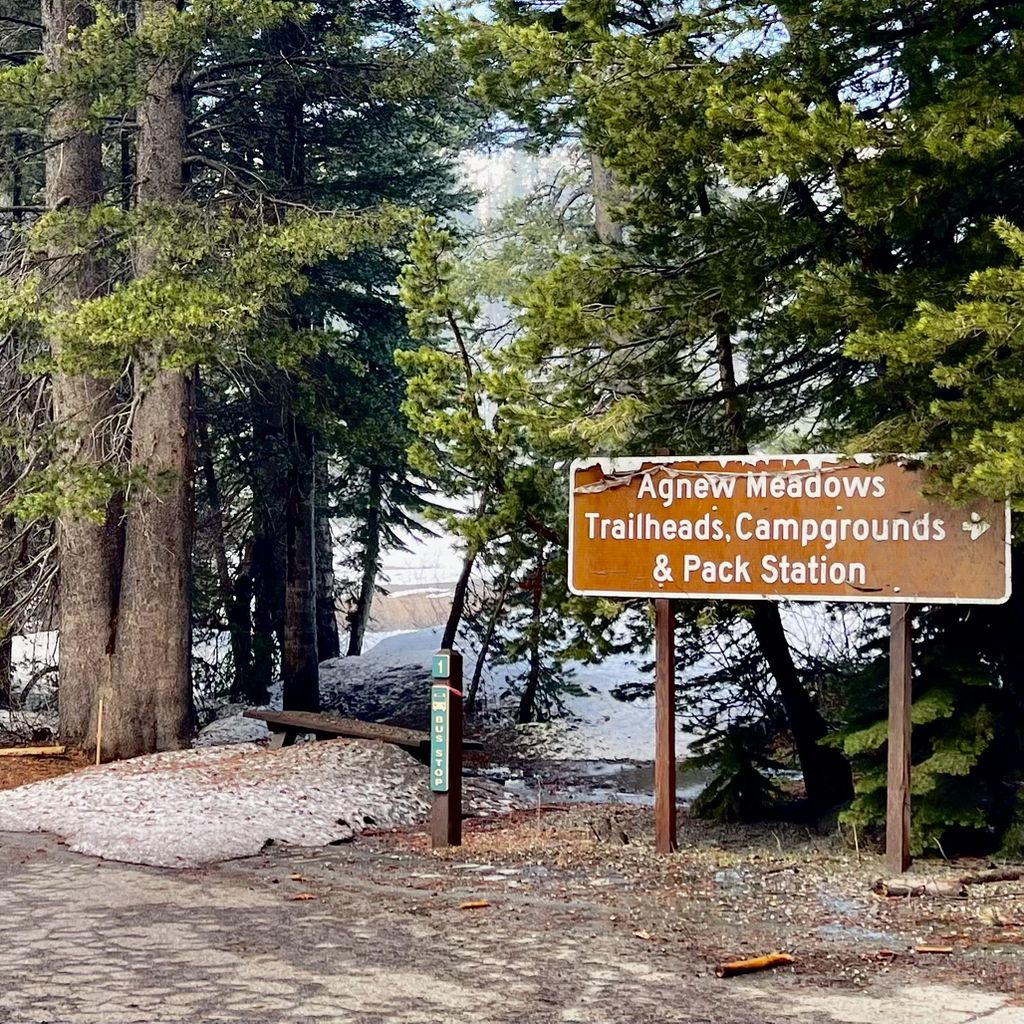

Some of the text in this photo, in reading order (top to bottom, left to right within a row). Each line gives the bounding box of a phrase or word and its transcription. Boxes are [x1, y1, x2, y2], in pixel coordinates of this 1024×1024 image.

[637, 472, 885, 507] Agnew Meadows
[585, 512, 945, 549] Trailheads, Campgrounds
[653, 555, 866, 584] & Pack Station
[438, 660, 443, 674] 1
[434, 715, 443, 786] BUS STOP
